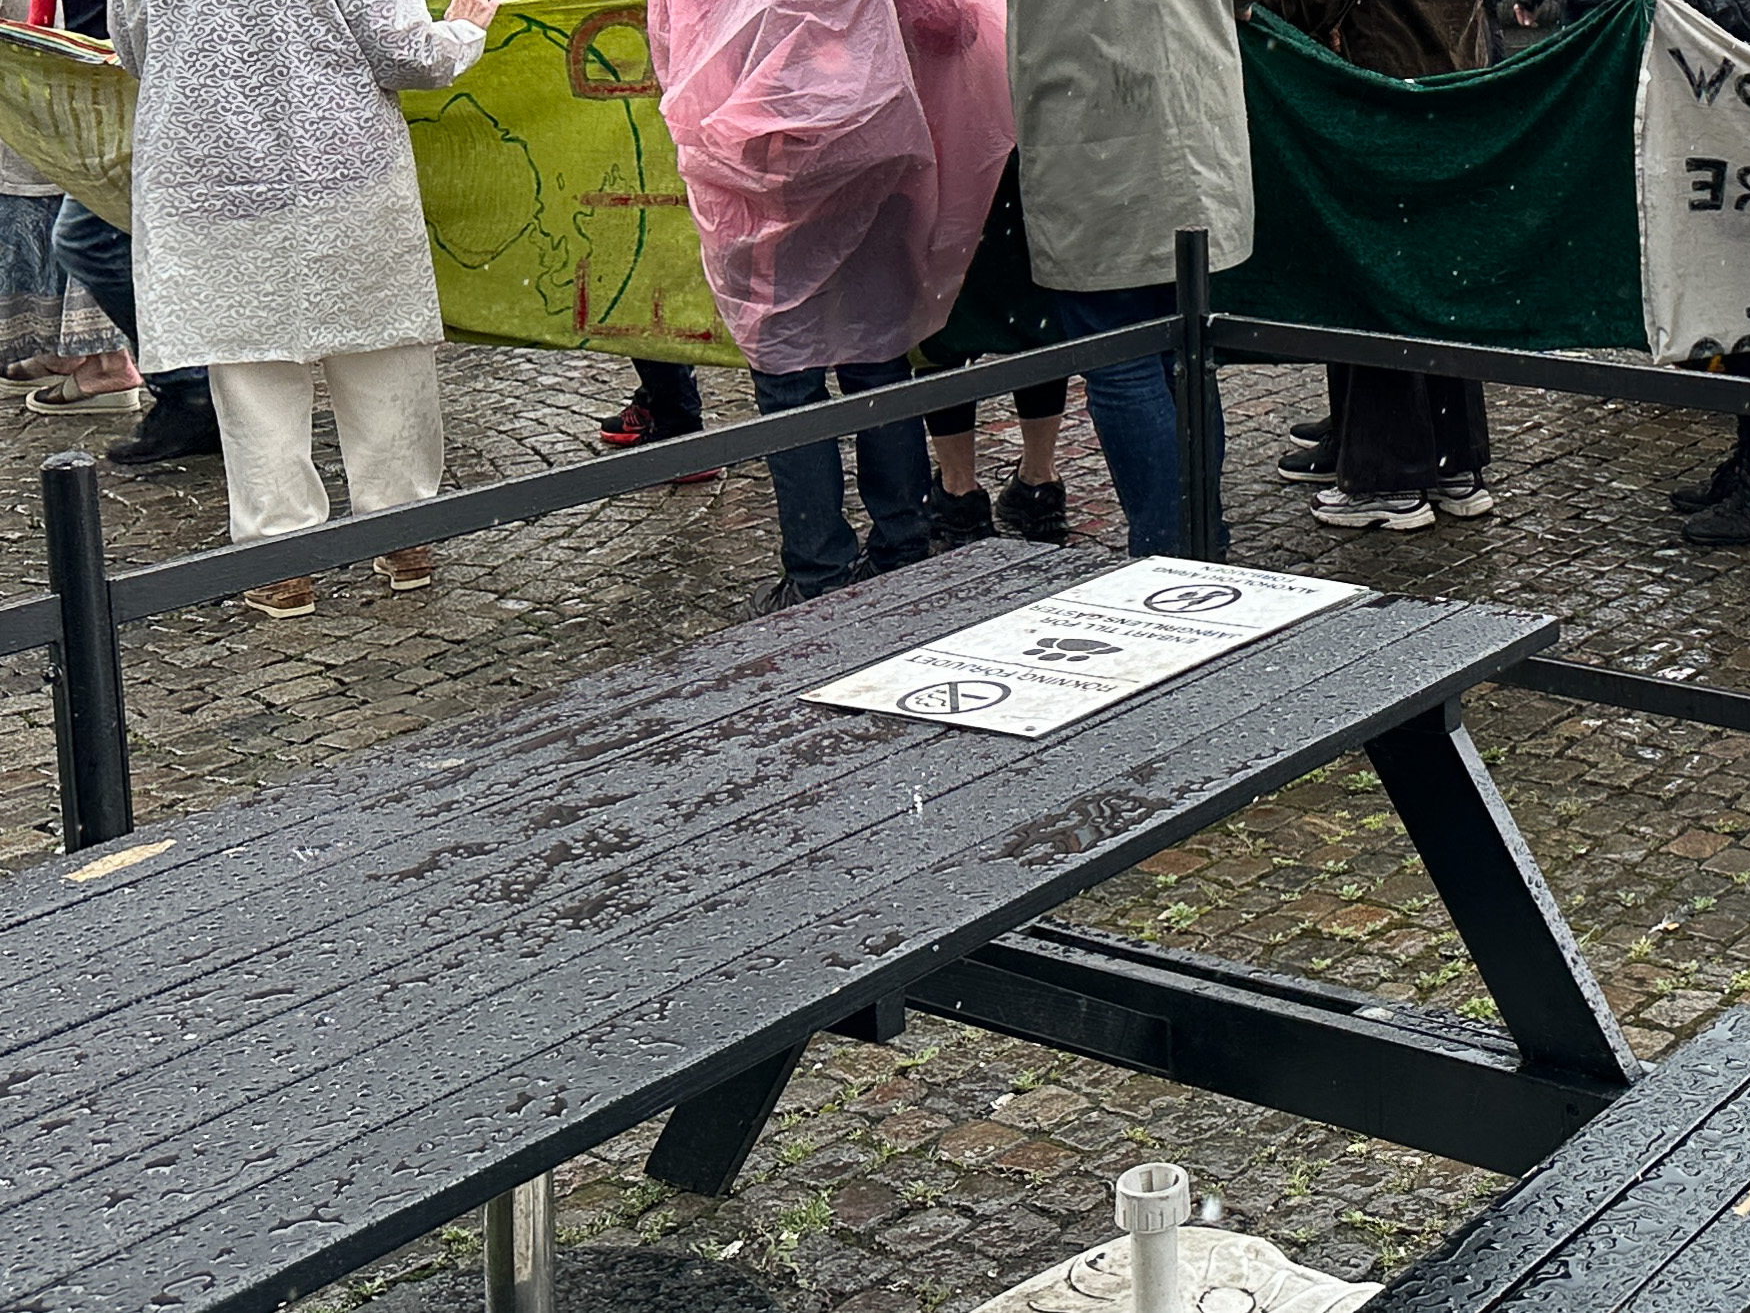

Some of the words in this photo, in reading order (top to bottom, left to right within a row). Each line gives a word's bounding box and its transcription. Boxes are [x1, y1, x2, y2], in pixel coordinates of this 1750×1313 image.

[1028, 604, 1105, 622] GÄSTER
[1039, 615, 1082, 629] FÖR
[1082, 624, 1118, 635] TILL
[1105, 615, 1244, 640] JÄRNGRILLENS
[1120, 628, 1201, 644] ENBART
[903, 655, 1018, 678] FÖRJUDET
[1017, 672, 1118, 692] RÖKNING
